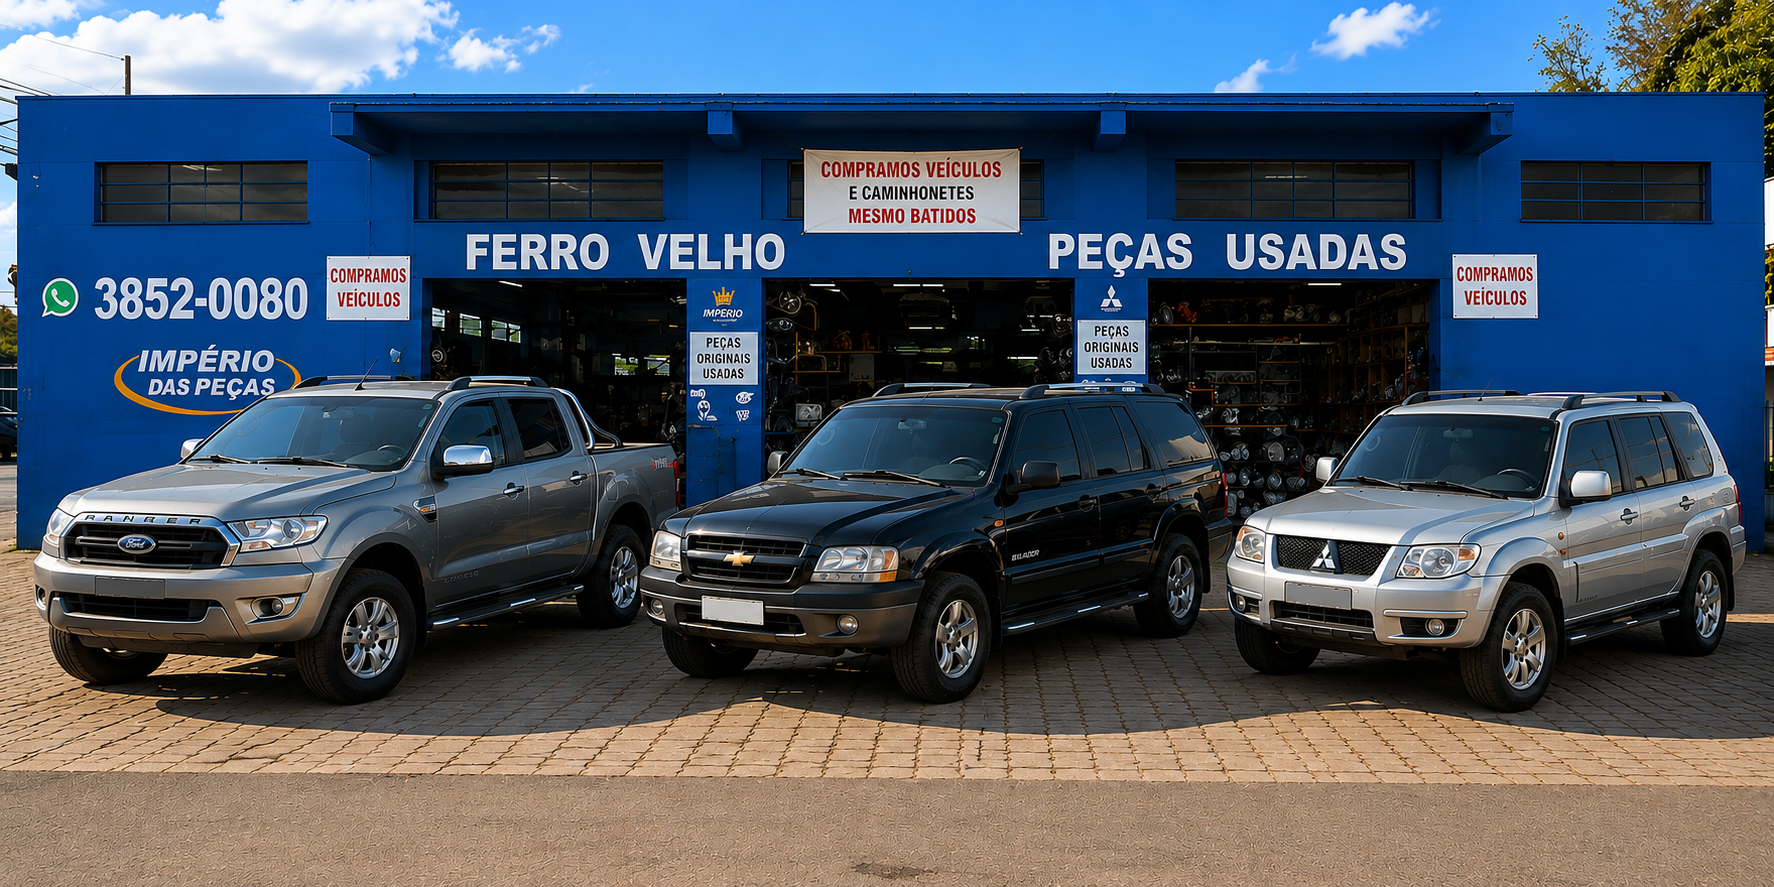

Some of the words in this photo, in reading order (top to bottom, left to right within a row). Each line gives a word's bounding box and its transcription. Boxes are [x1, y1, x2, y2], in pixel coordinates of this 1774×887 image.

[821, 160, 921, 178] COMPRAMOS
[925, 157, 1002, 178] VEÍCULOS
[849, 185, 858, 200] E
[862, 185, 975, 200] CAMINHONETES
[848, 208, 905, 224] MESMO
[910, 208, 977, 224] BATIDOS
[466, 233, 610, 271] FERRO
[637, 233, 785, 271] VELHO
[1049, 233, 1193, 278] PEÇAS
[1226, 233, 1407, 271] USADAS
[330, 267, 407, 284] COMPRAMOS
[1456, 266, 1534, 282] COMPRAMOS
[94, 276, 308, 320] 3852-0080
[337, 288, 401, 308] VEÍCULOS
[1464, 287, 1527, 306] VEÍCULOS
[1094, 326, 1130, 339] PEÇAS
[706, 337, 741, 351] PEÇAS
[1084, 341, 1139, 353] ORIGINAIS
[138, 344, 275, 373] IMPÉRIO
[696, 353, 751, 365] ORIGINAIS
[1091, 357, 1133, 369] USADAS
[702, 368, 744, 379] USADAS
[148, 378, 191, 396] DAS
[194, 378, 276, 400] PEÇAS
